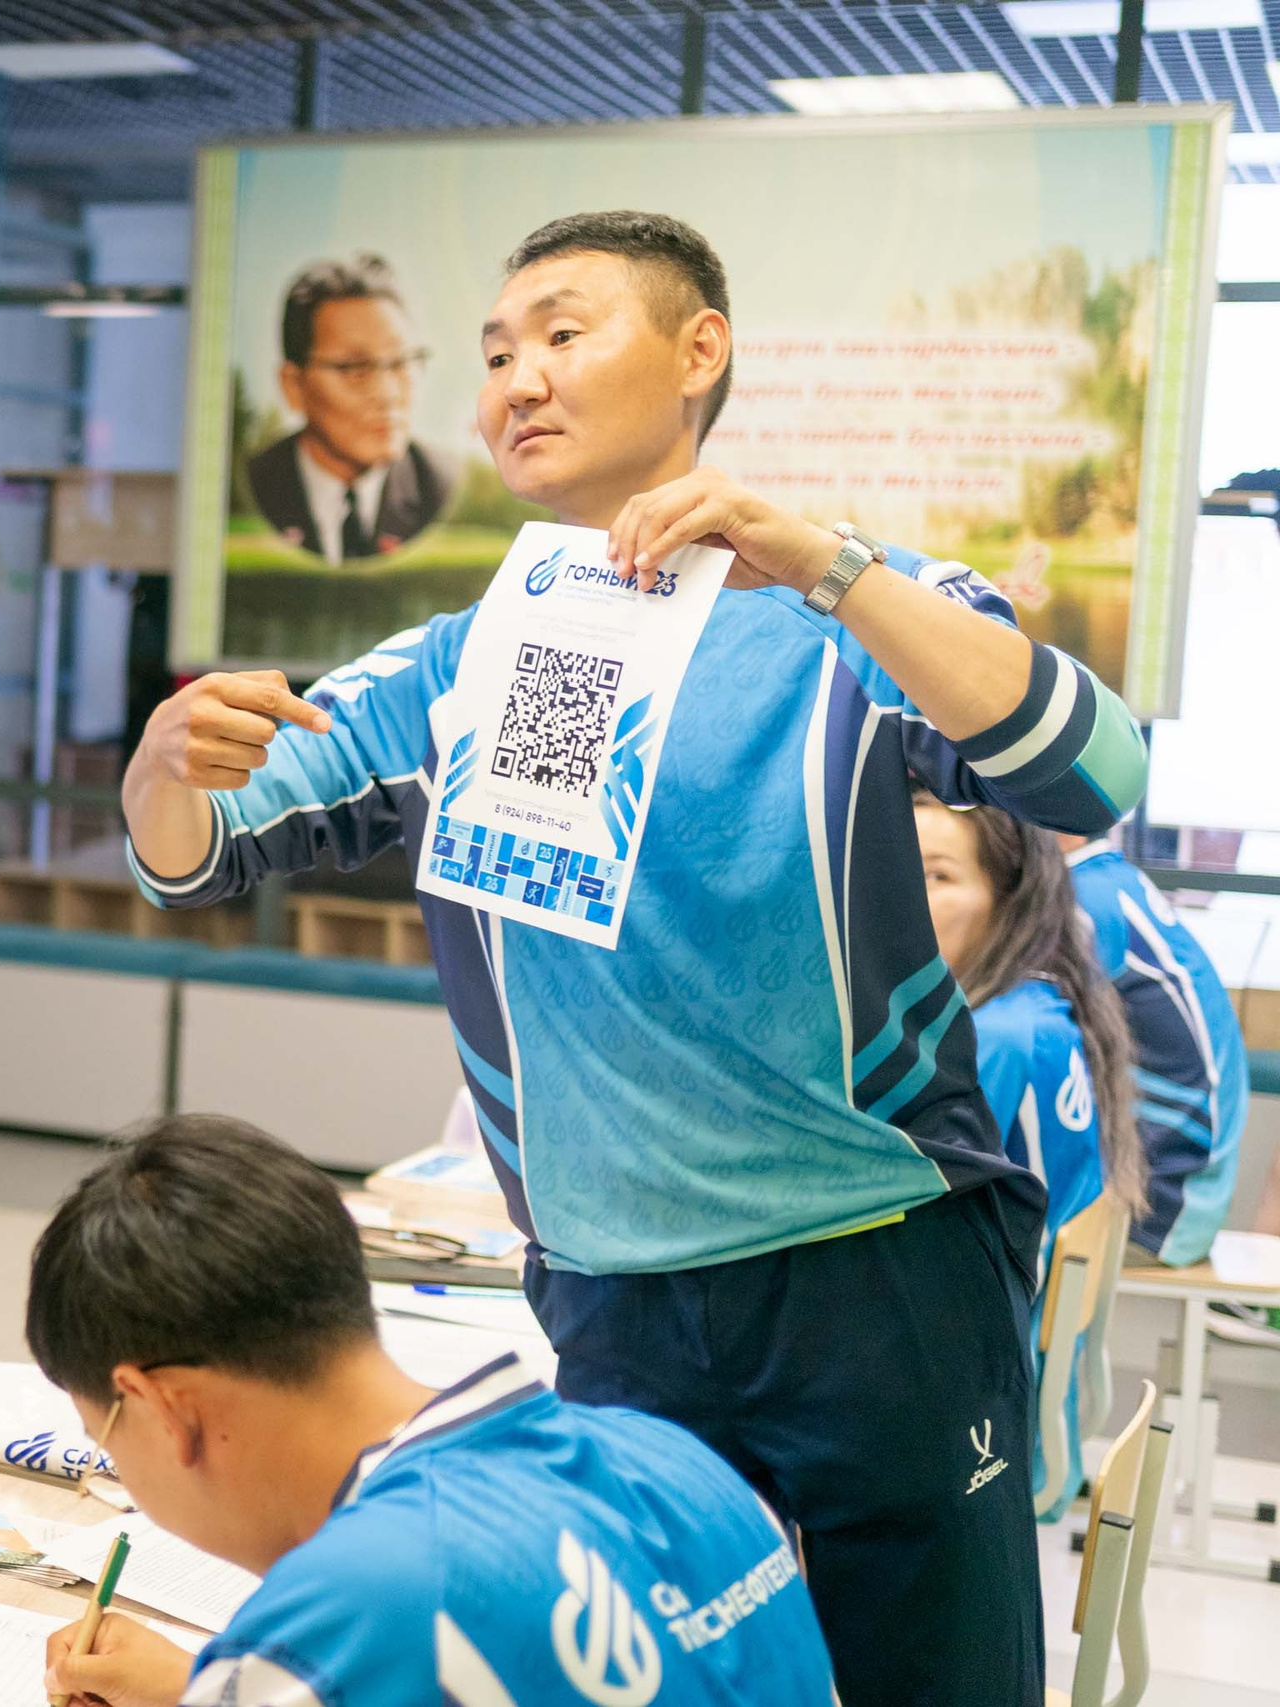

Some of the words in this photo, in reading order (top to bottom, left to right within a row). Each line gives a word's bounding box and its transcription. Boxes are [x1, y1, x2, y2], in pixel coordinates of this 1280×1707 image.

[494, 803, 501, 813] 8
[502, 804, 524, 820] (924)
[525, 811, 572, 832] 898-11-40
[63, 1448, 113, 1470] САХ
[965, 1458, 1009, 1494] JÖGEL
